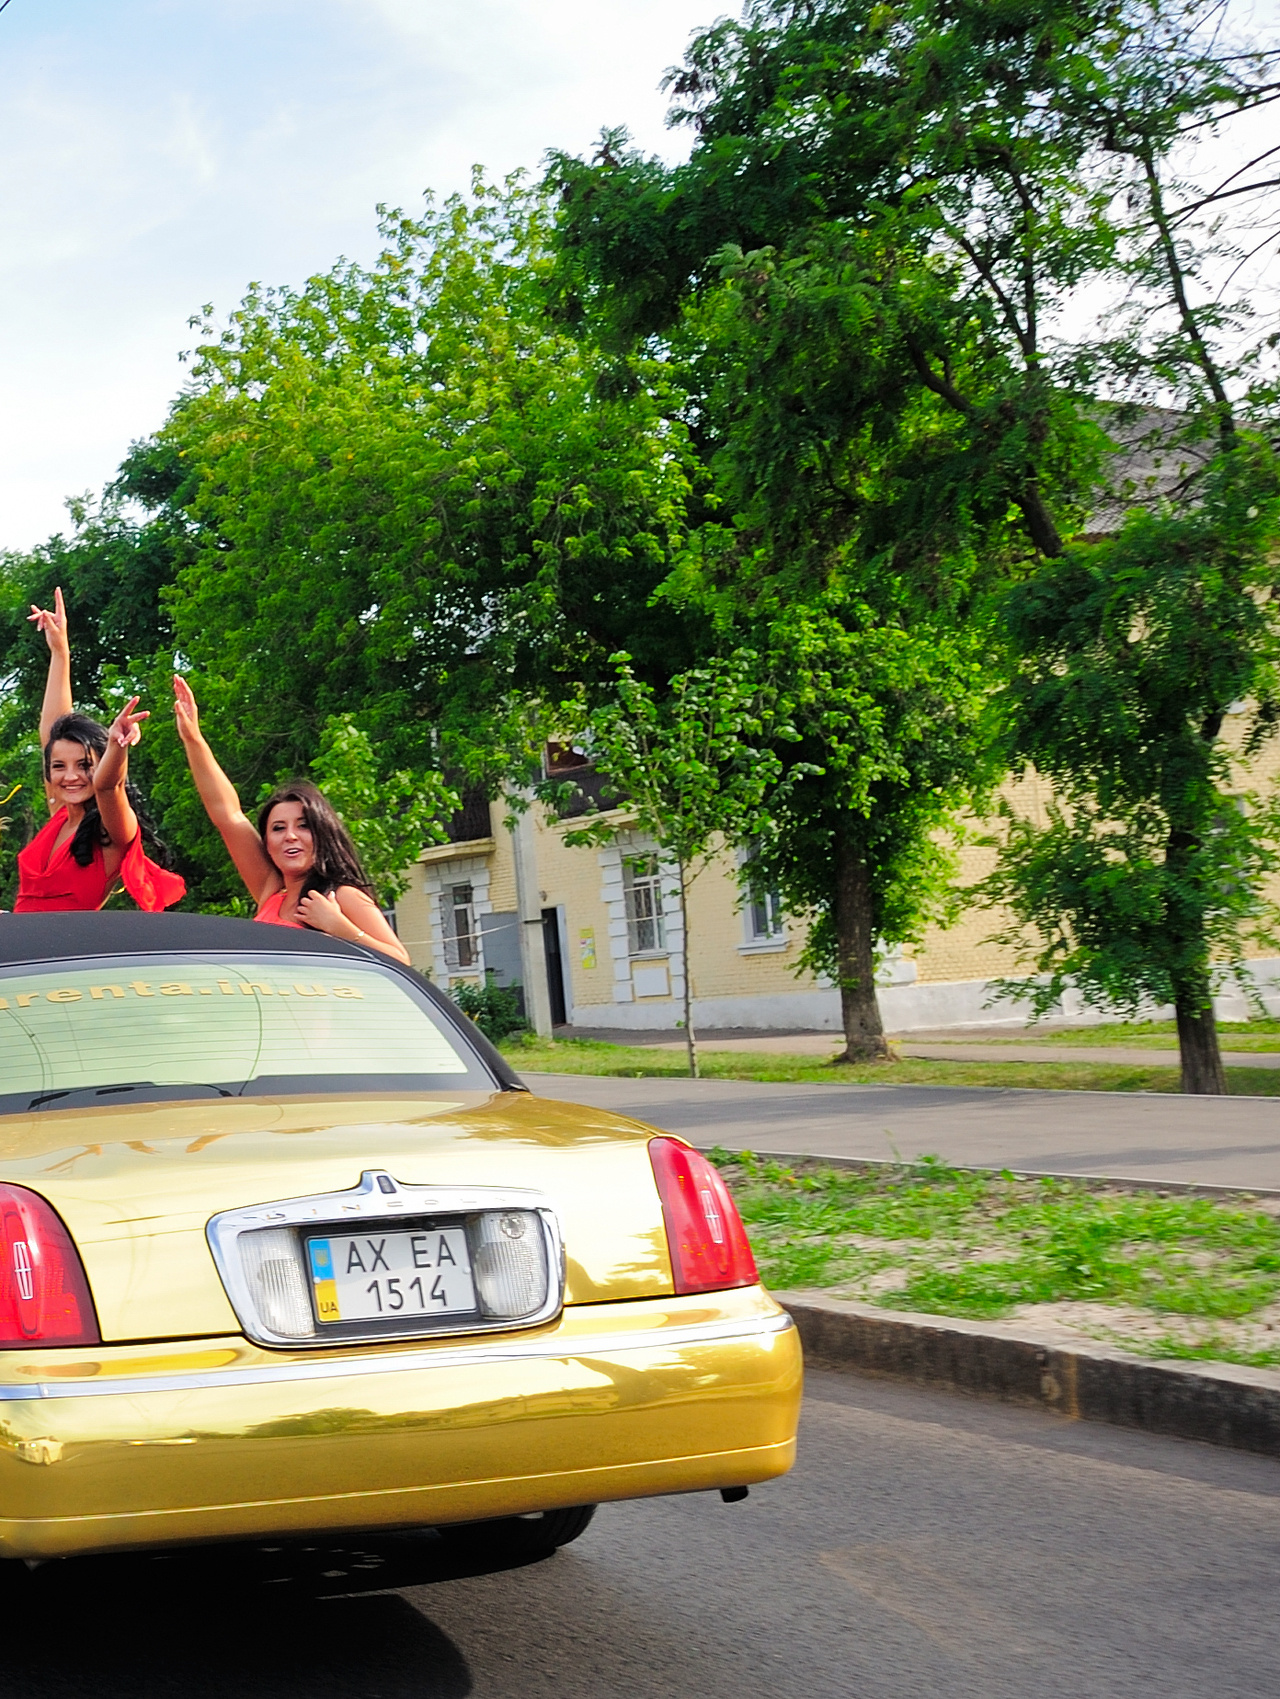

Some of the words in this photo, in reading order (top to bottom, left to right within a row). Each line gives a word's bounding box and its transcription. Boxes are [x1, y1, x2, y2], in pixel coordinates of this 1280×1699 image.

[346, 1238, 391, 1274] AX
[410, 1234, 457, 1269] EA
[319, 1301, 339, 1313] UA
[366, 1274, 448, 1312] 1514
